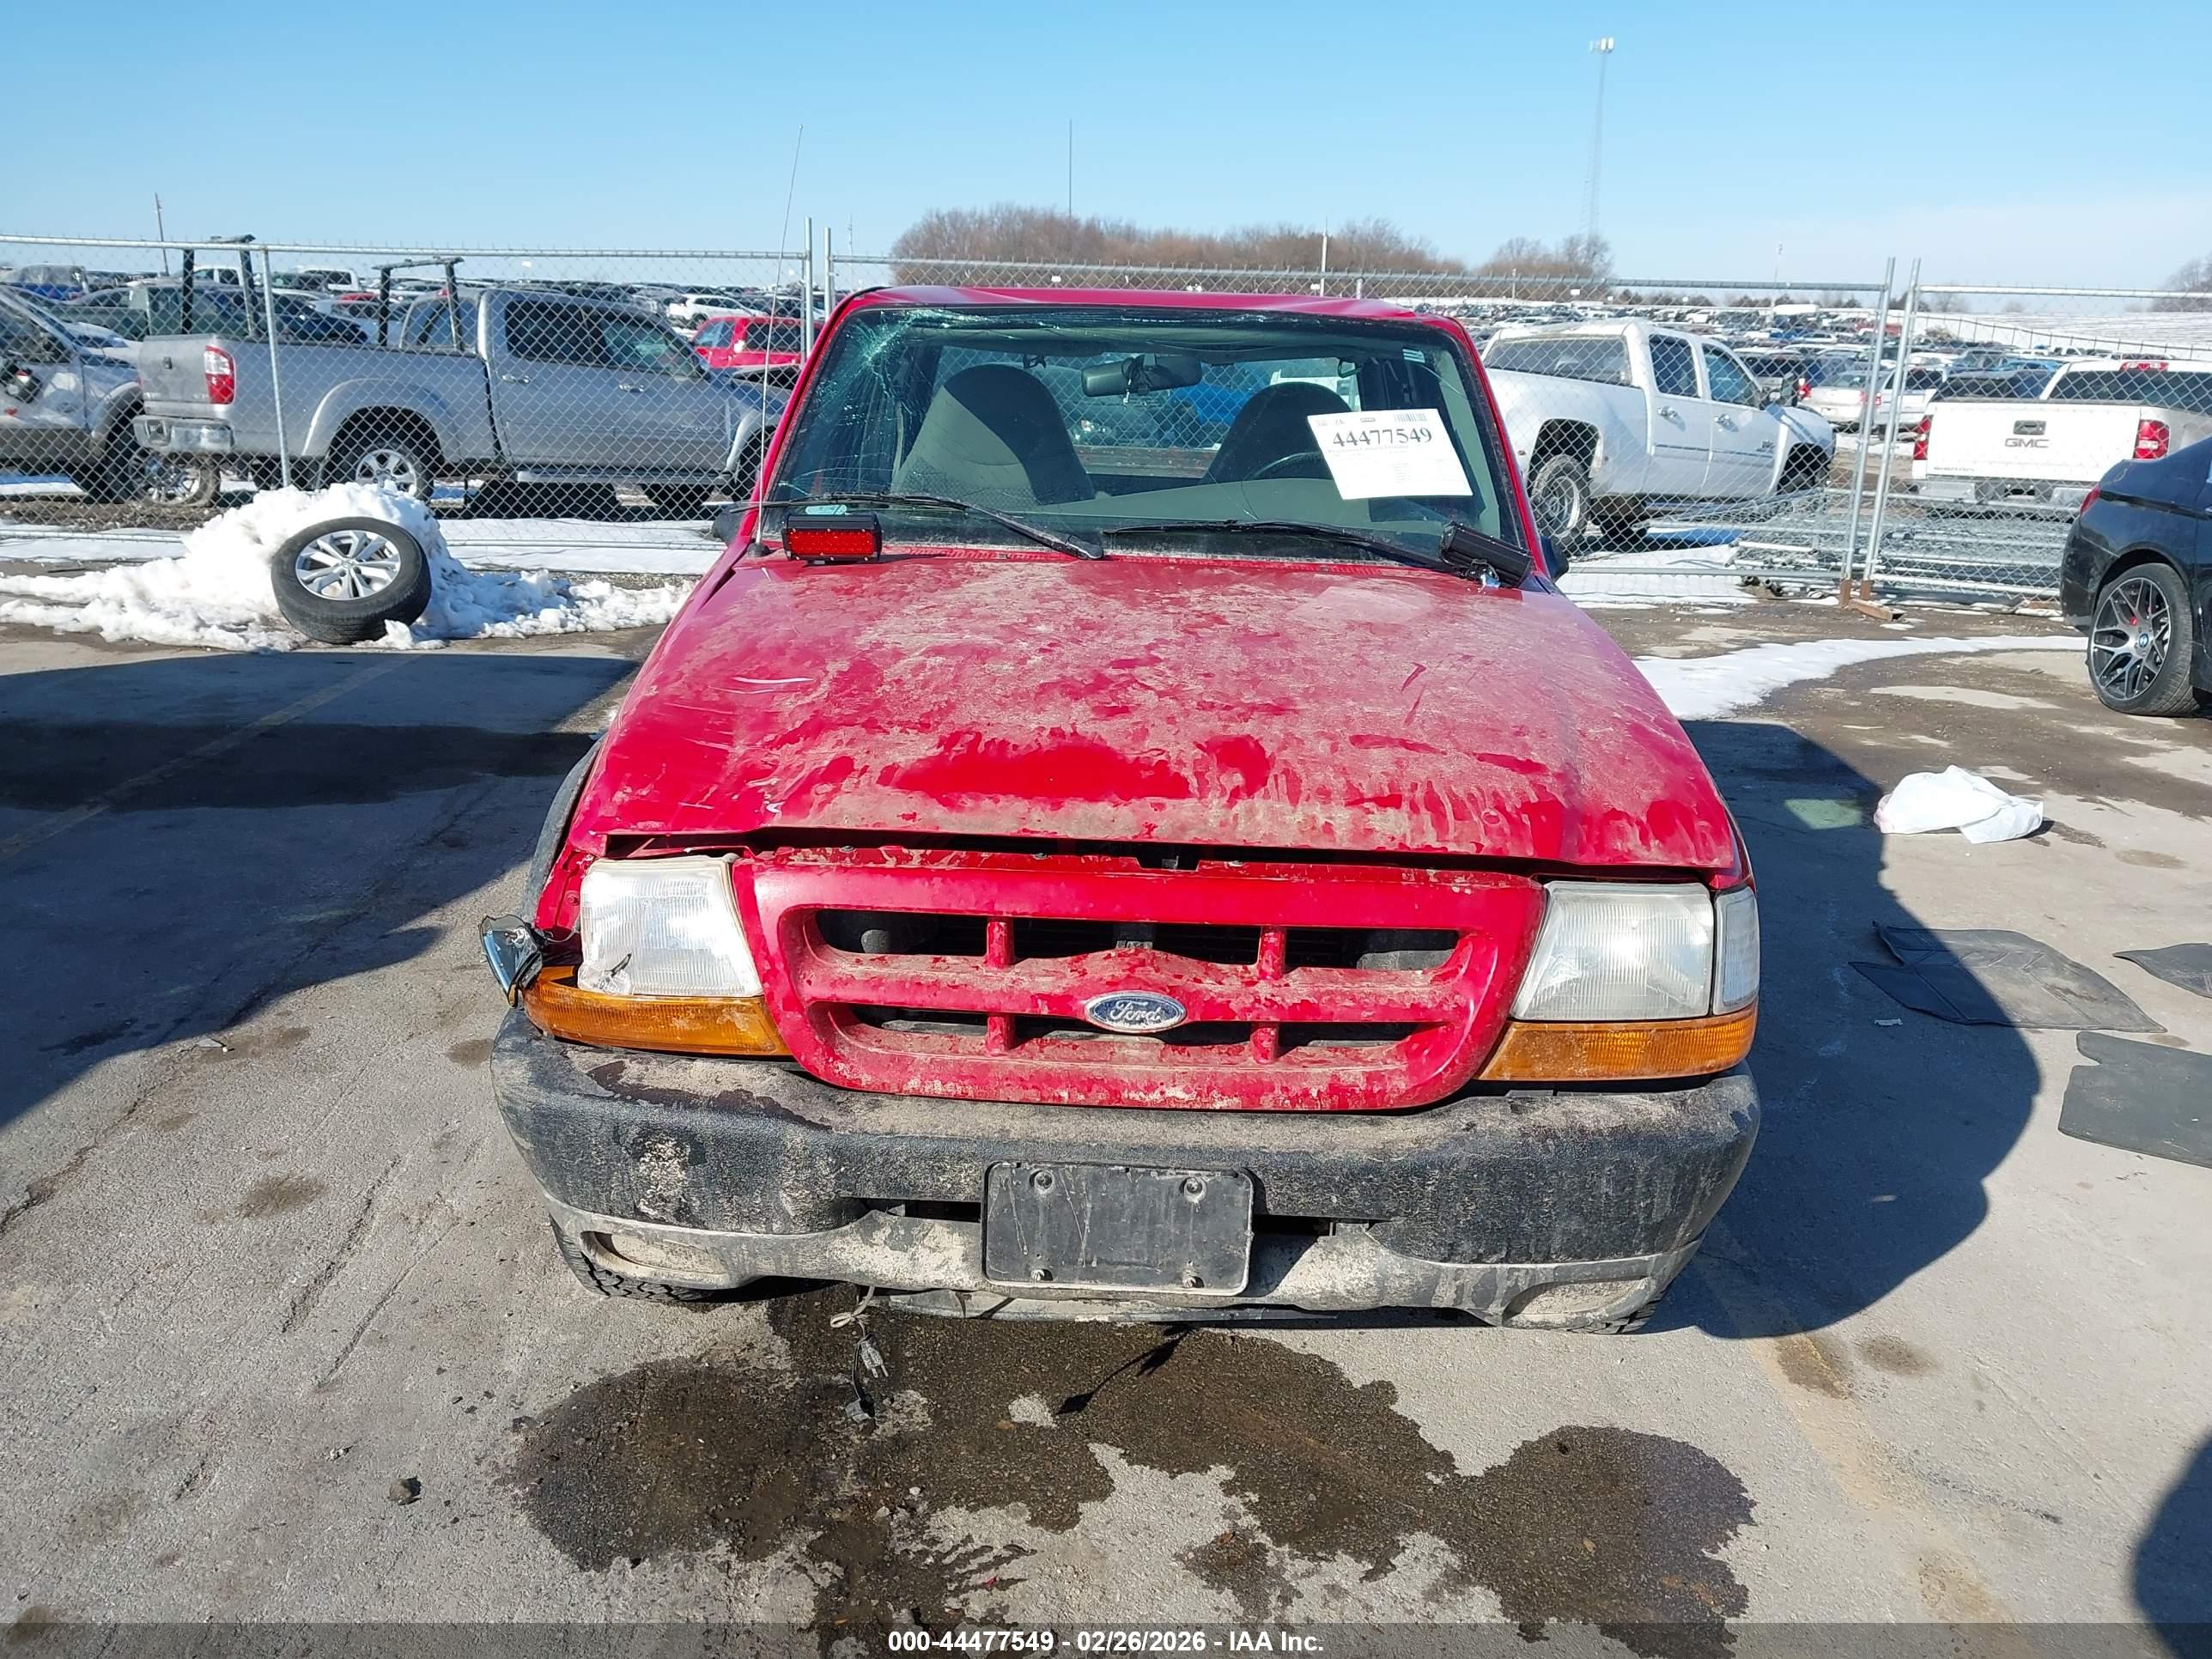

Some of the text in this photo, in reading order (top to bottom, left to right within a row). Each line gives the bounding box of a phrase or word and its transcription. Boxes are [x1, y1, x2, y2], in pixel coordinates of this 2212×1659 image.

[1333, 427, 1432, 447] 44477549
[2004, 437, 2050, 448] GMC
[1110, 1000, 1162, 1022] Ford
